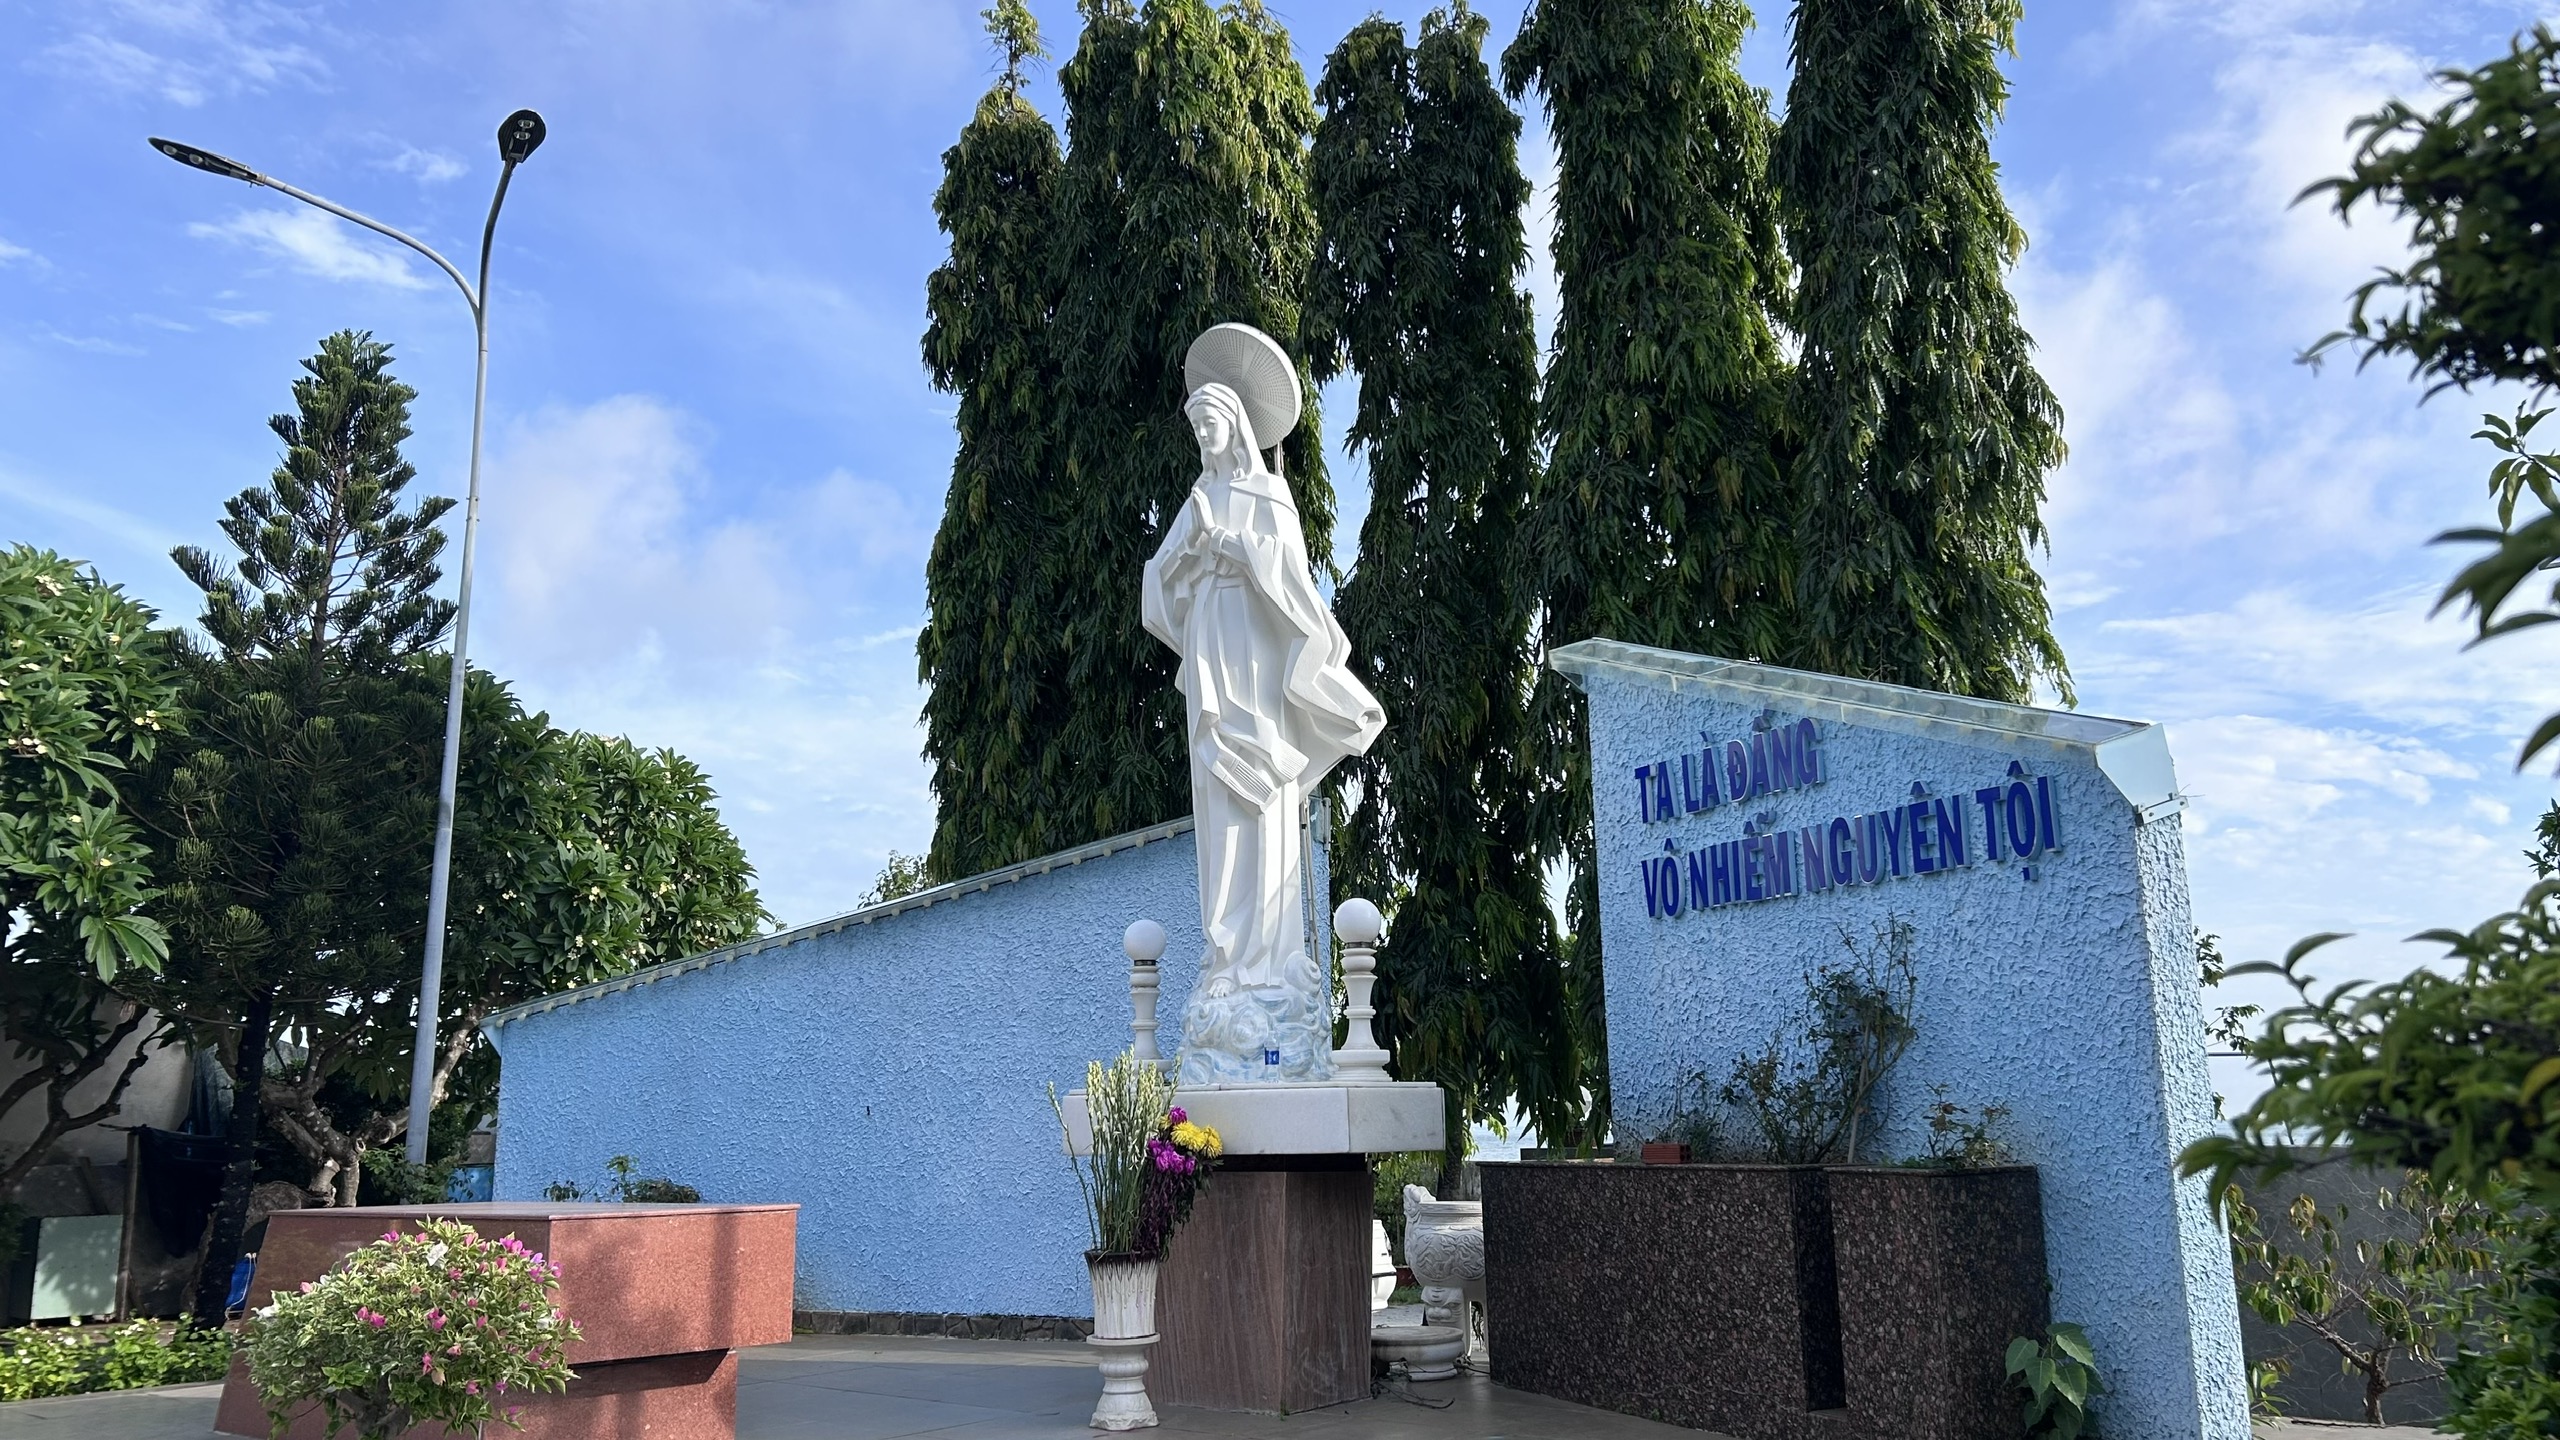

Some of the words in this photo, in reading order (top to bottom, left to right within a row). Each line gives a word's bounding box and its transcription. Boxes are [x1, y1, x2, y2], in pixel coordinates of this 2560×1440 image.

[1635, 763, 1680, 824] TA
[1682, 731, 1726, 814] LÀ
[1641, 837, 1685, 919] VÔ
[1689, 810, 1798, 911] NHIỄM
[1801, 780, 1971, 893] NGUYÊN
[1975, 759, 2061, 882] TỘI
